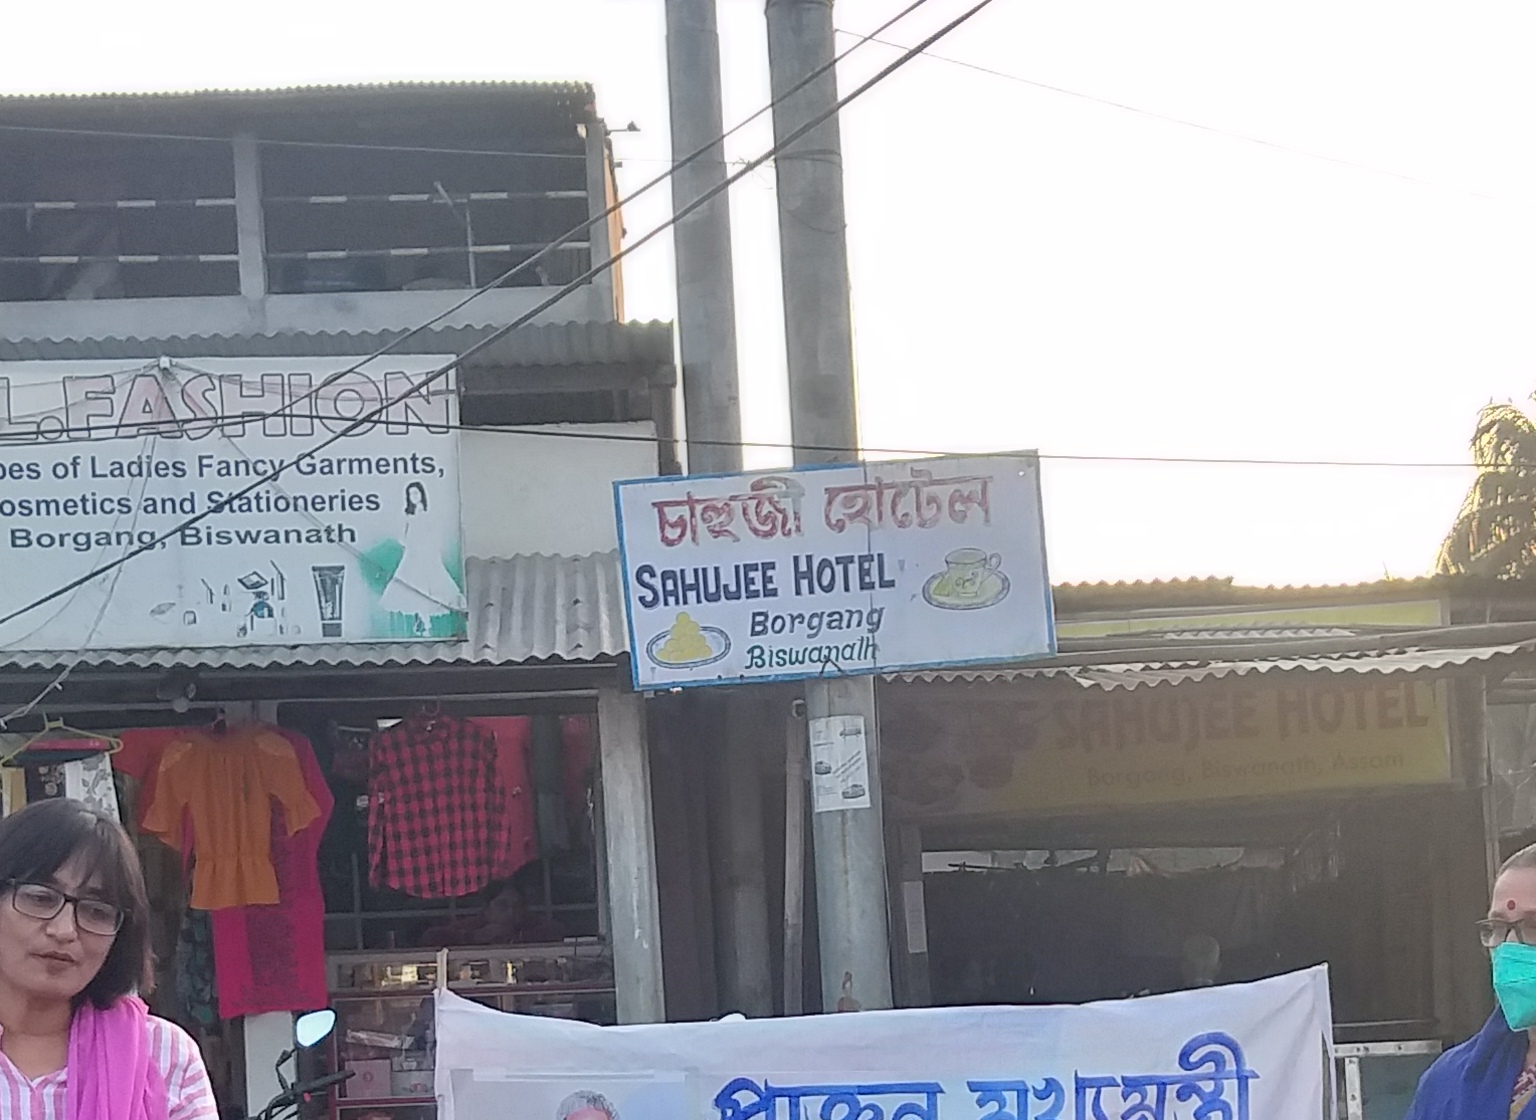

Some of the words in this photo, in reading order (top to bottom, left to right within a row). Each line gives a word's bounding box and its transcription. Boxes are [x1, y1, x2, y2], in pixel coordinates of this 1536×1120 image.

[52, 456, 81, 480] of
[90, 454, 187, 480] Ladies
[198, 453, 285, 483] Fancy
[296, 452, 445, 479] Garments,
[143, 491, 196, 515] and
[207, 489, 381, 514] Stationeries
[824, 467, 994, 533] হোটেল
[10, 527, 166, 552] Borgang,
[180, 523, 357, 547] Biswanath
[635, 560, 779, 609] SAHUJEE
[793, 553, 896, 595] HOTEL
[750, 604, 885, 639] Borgang
[1052, 690, 1260, 752] SAHUJEE
[1278, 680, 1429, 741] HOTEL
